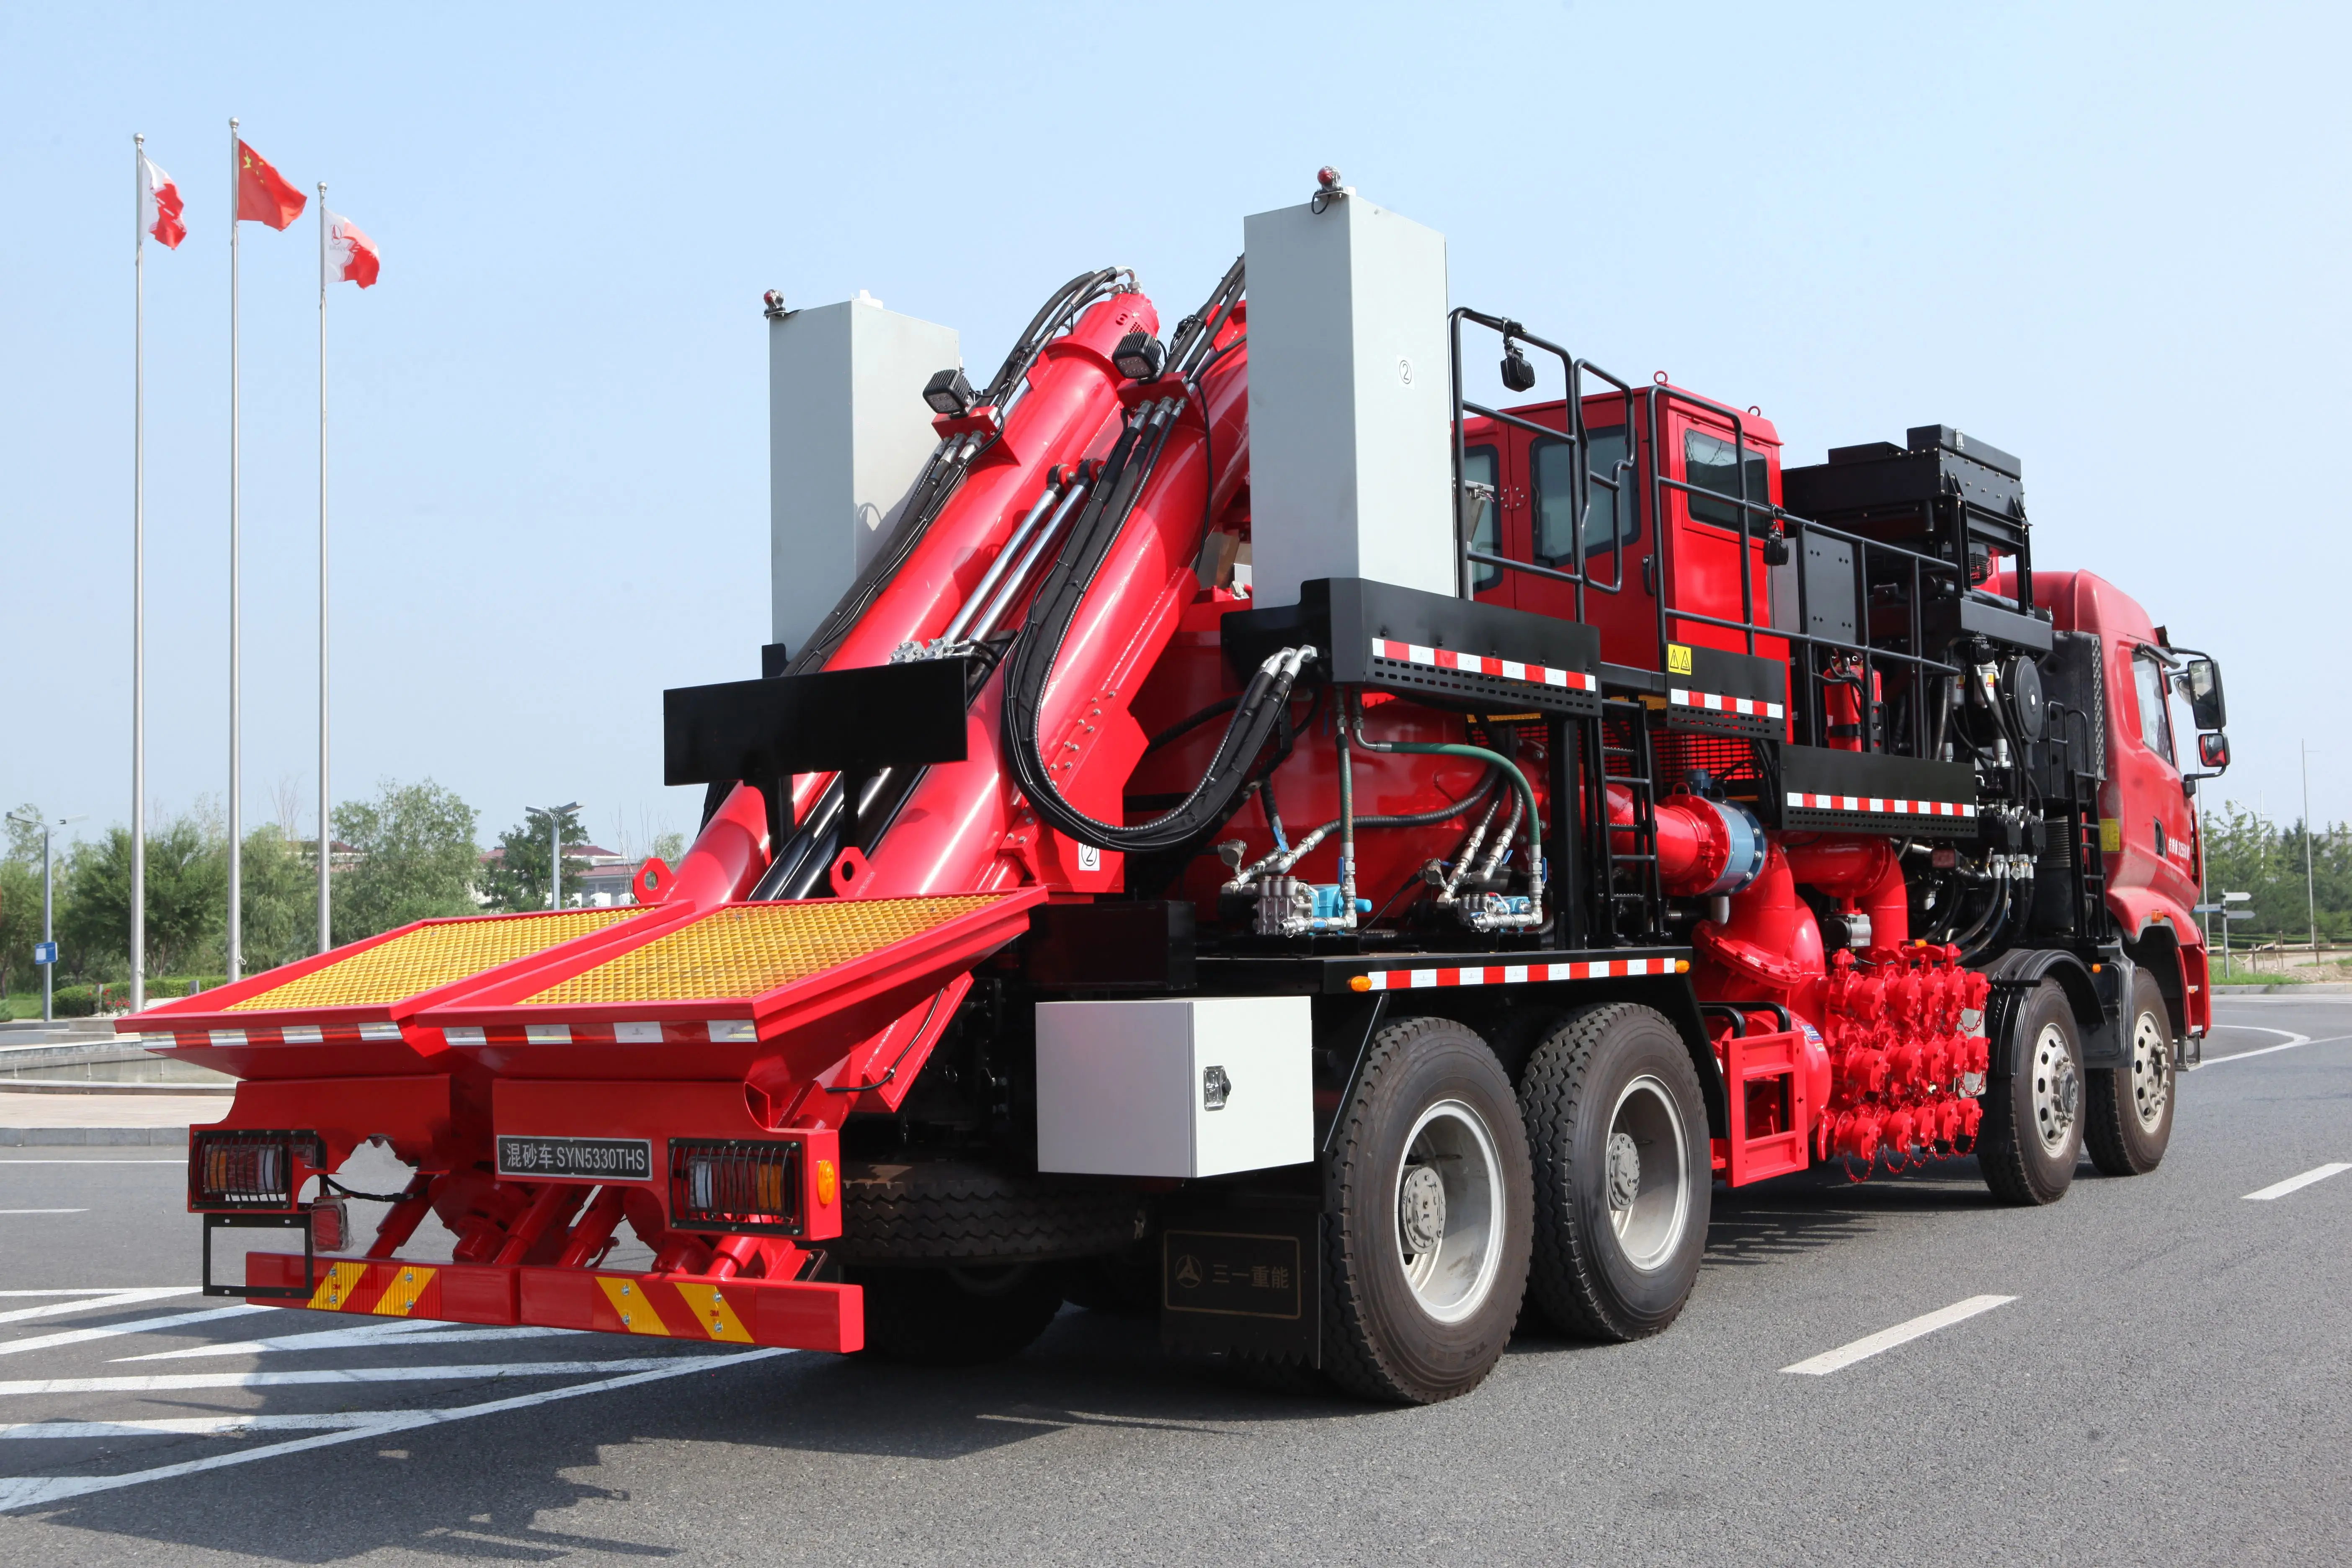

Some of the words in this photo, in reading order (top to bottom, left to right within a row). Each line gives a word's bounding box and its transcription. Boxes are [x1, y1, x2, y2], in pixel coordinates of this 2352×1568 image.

[507, 1142, 553, 1169] 混砂车
[557, 1147, 645, 1171] SYN5330THS
[1212, 1264, 1289, 1289] 三一重能
